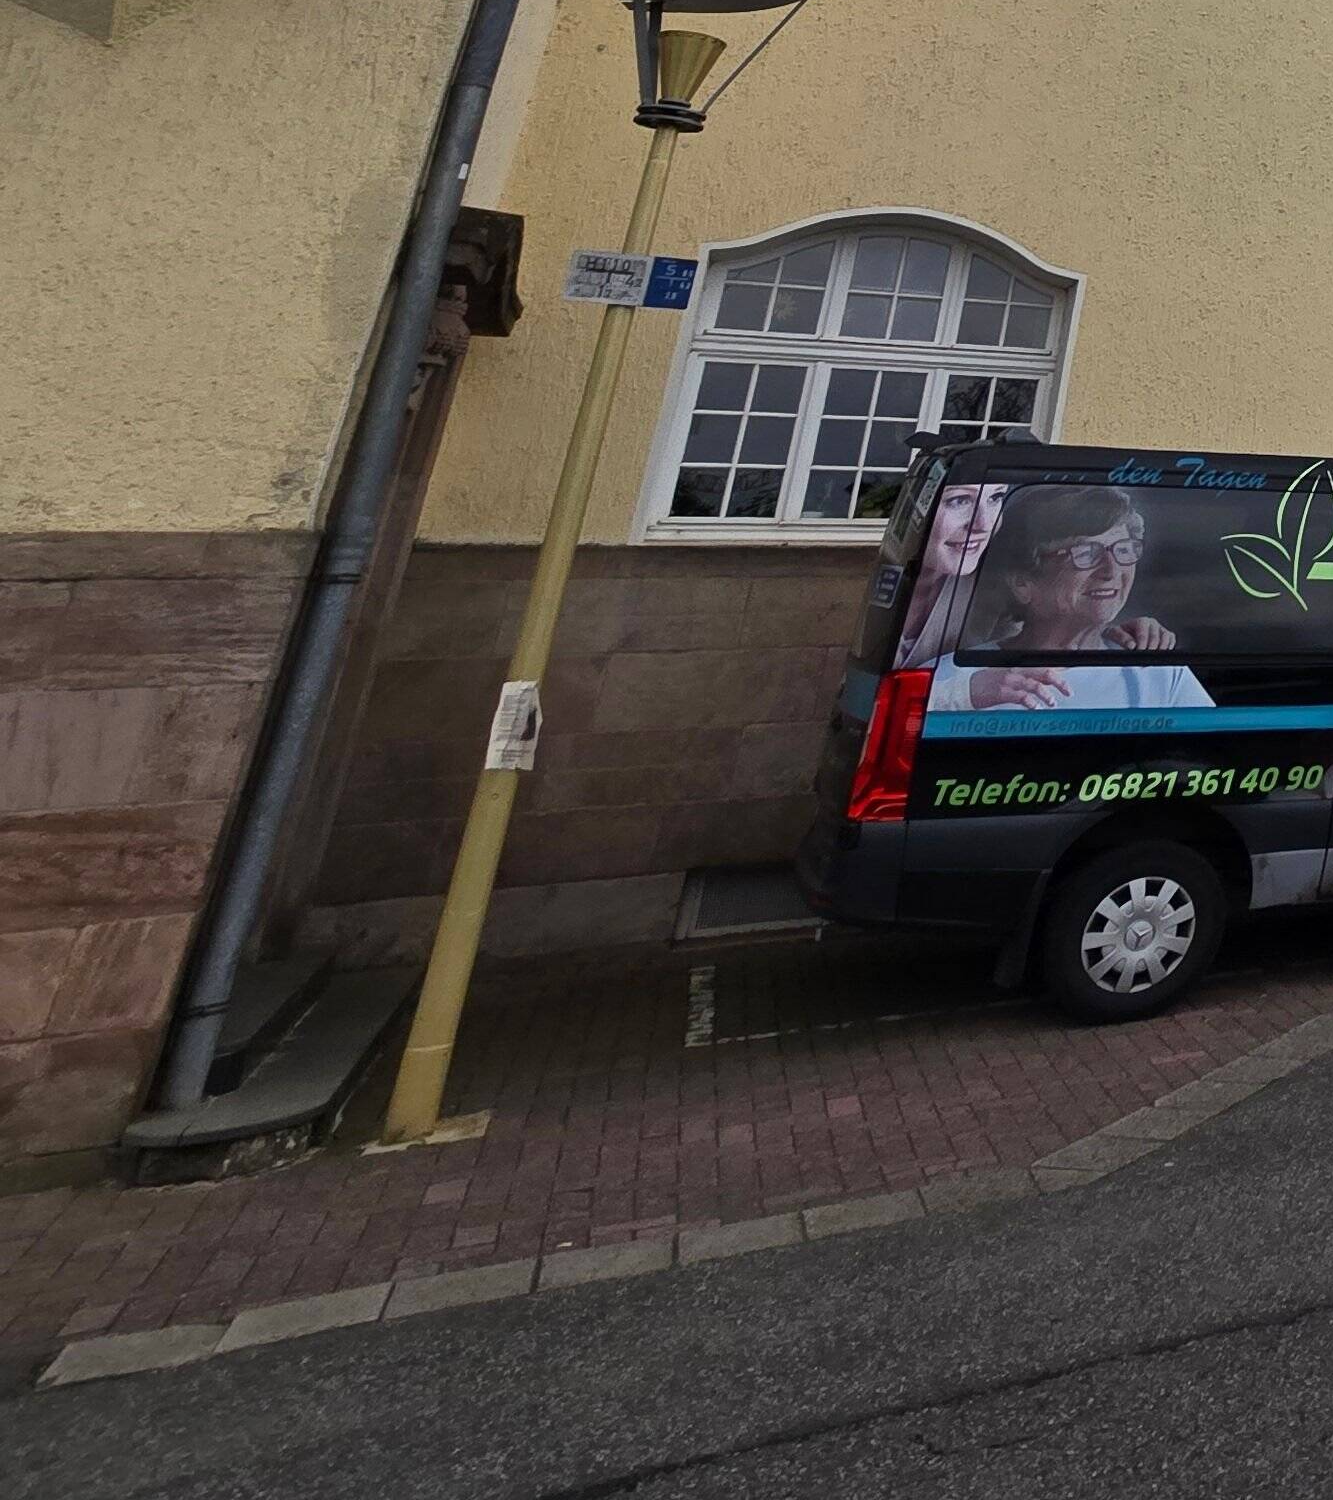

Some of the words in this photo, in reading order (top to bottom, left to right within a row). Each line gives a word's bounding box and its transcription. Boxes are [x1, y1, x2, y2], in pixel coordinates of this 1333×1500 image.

[1108, 457, 1163, 485] den
[1175, 457, 1268, 498] Tagen
[949, 716, 1176, 735] info@aktiv-seniorpflege.de
[934, 773, 1071, 806] Telefon:
[1078, 770, 1179, 802] 06821
[1182, 769, 1236, 797] 361
[1239, 766, 1281, 794] 40
[1285, 764, 1325, 792] 90
